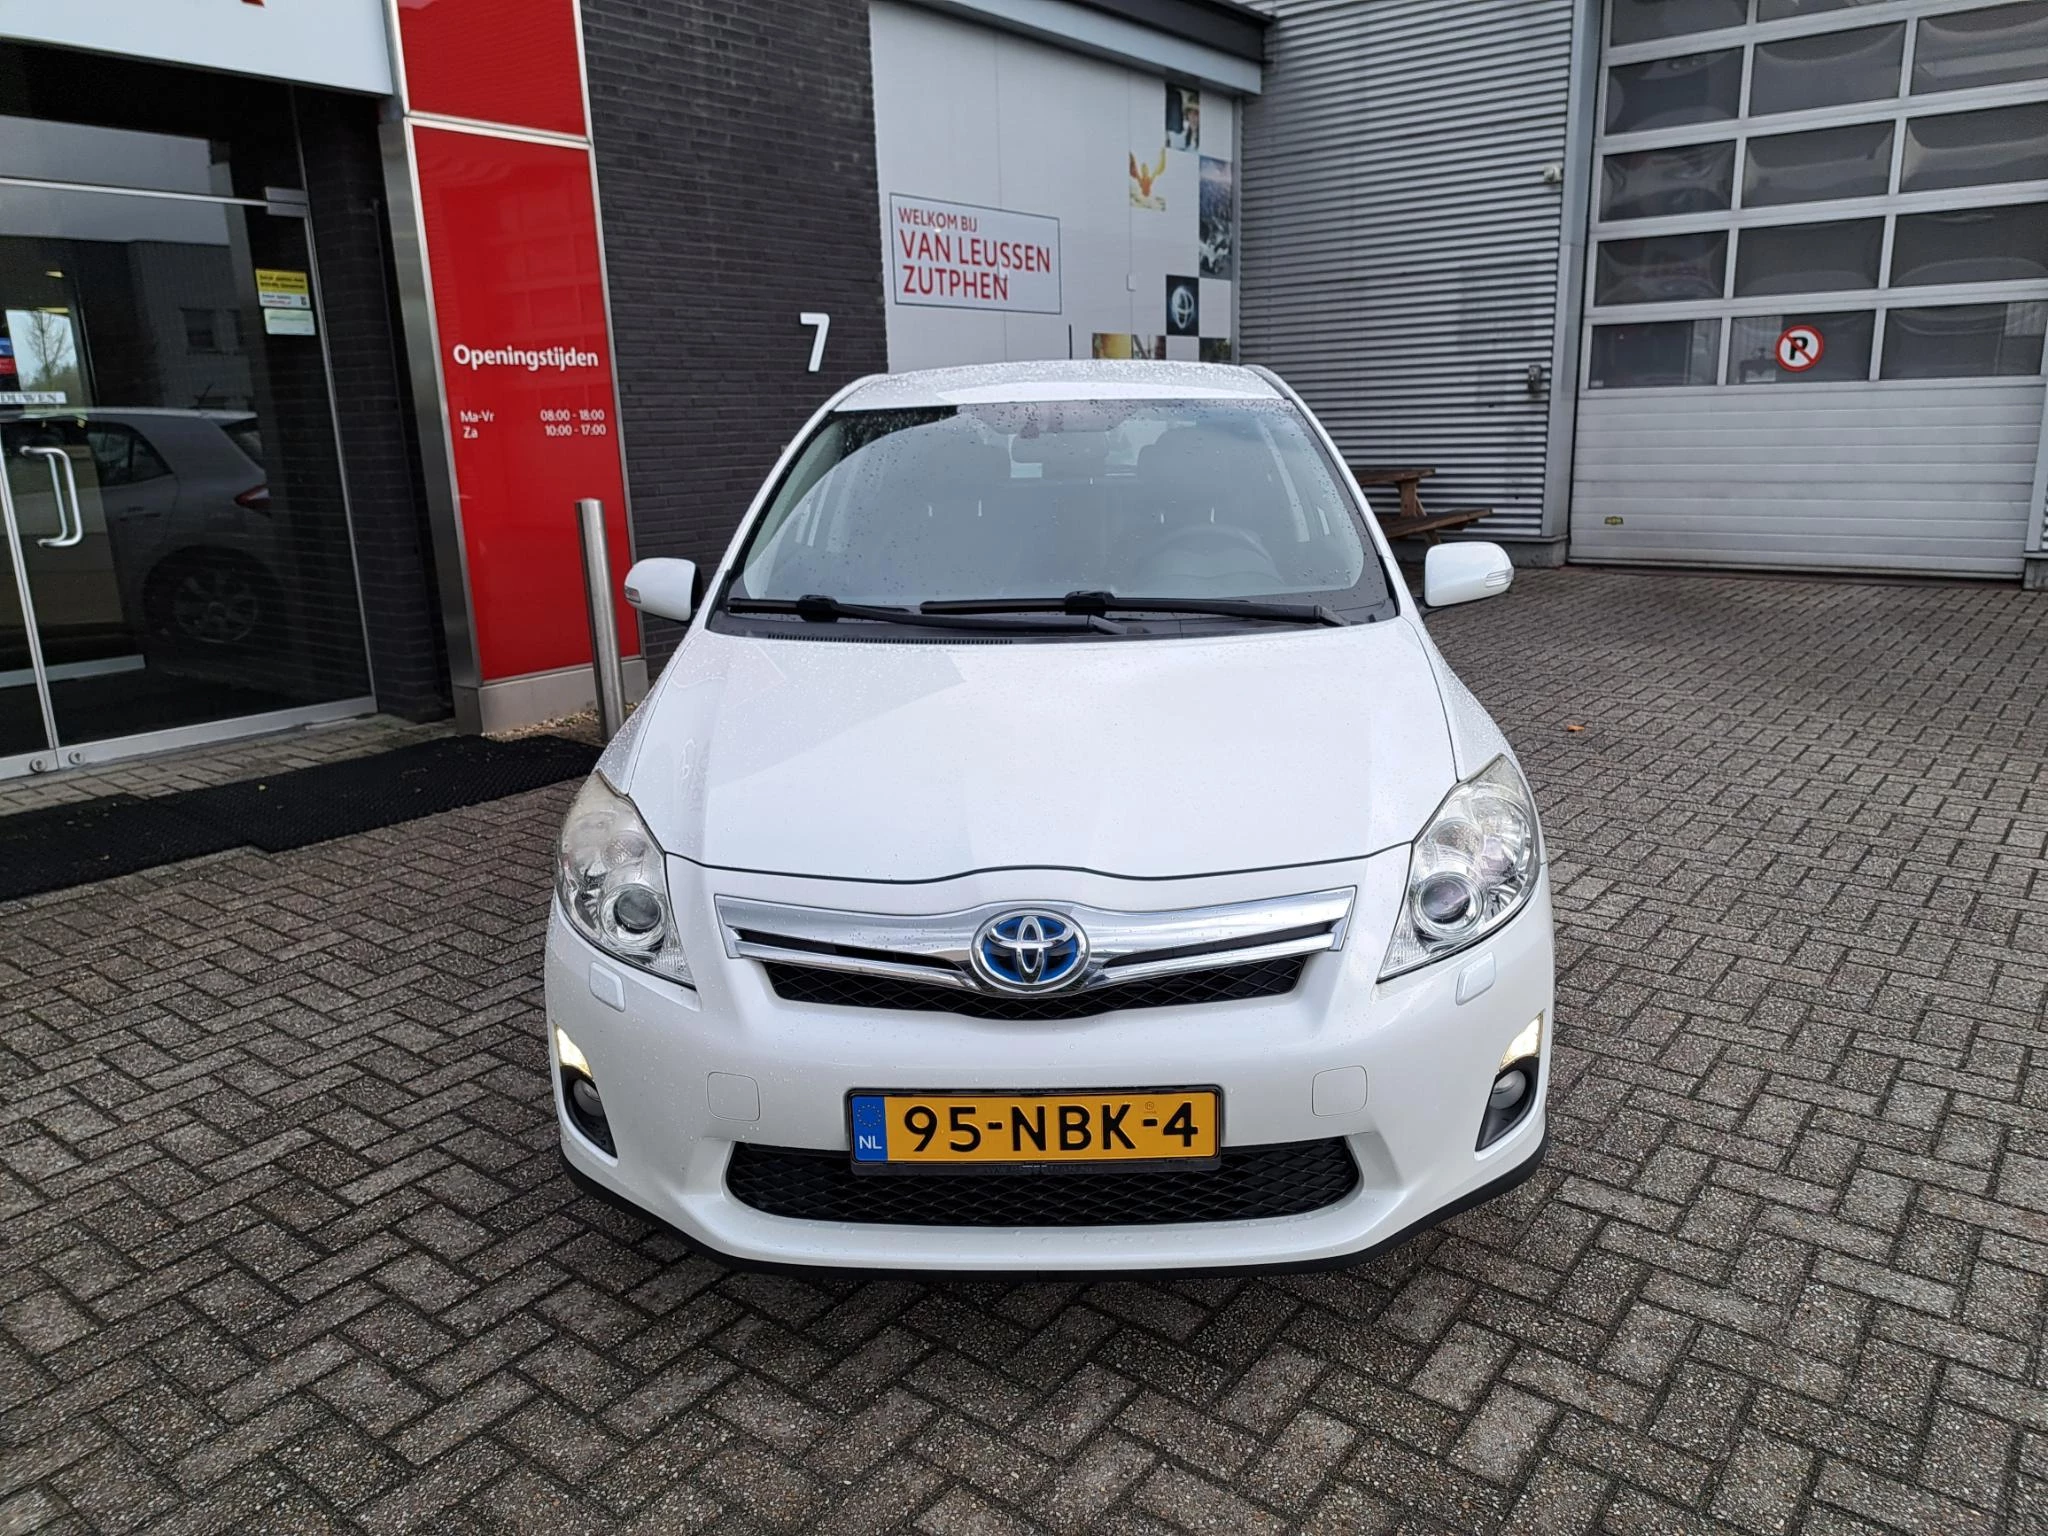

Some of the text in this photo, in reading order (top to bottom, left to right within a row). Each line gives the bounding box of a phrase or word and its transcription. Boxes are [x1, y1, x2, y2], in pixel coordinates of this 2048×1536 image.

[898, 207, 978, 233] WELKOM BIJ
[900, 229, 1051, 273] VAN LEUSSEN
[903, 265, 1008, 301] ZUTPHEN
[800, 312, 830, 372] 7
[453, 344, 599, 371] Openingstijden
[460, 410, 495, 423] Ma-Vr
[540, 409, 570, 421] 08:00
[579, 409, 605, 421] 18:00
[463, 426, 479, 439] Za
[545, 424, 572, 436] 10:00
[581, 424, 607, 436] 17:00
[903, 1102, 1199, 1152] 95-NBK-4
[859, 1136, 882, 1150] NL
